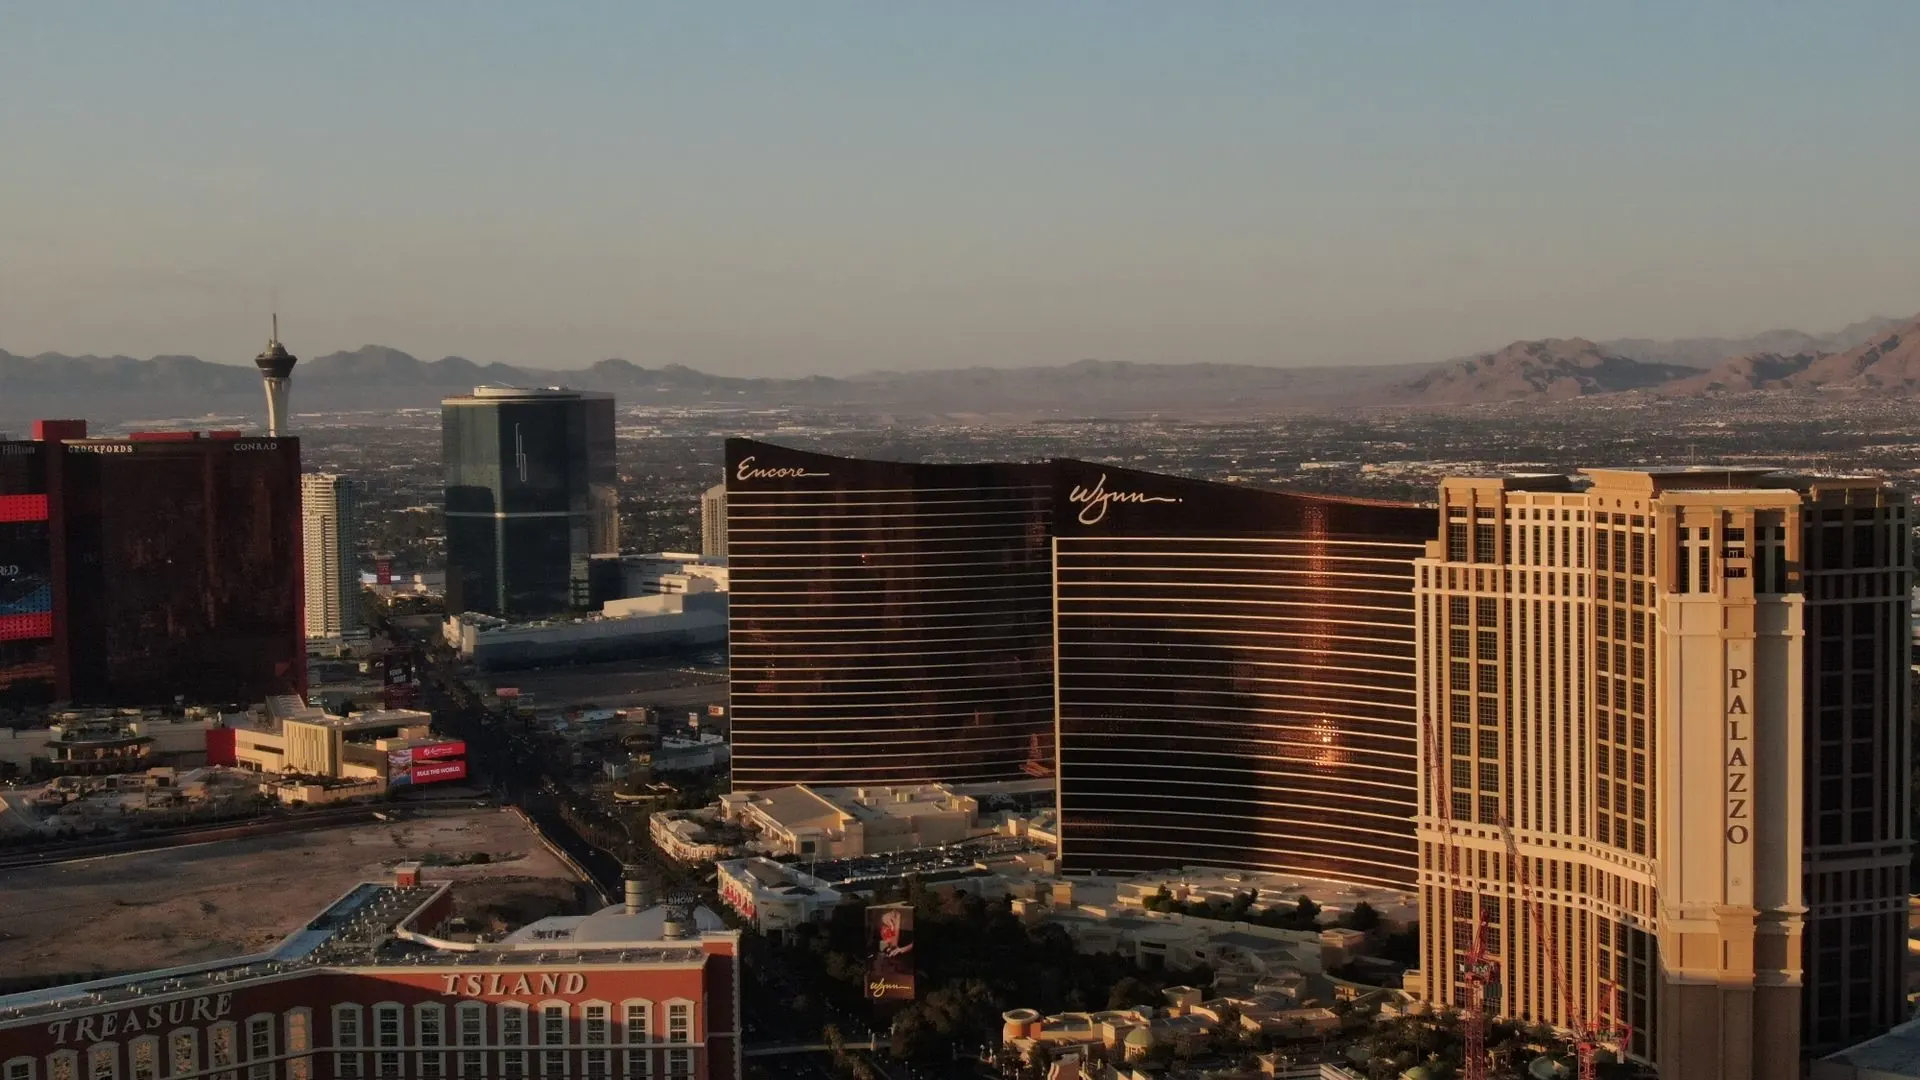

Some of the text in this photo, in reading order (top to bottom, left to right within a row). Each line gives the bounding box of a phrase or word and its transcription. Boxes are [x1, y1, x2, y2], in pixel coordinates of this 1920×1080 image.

[68, 445, 134, 454] CROCKFORDS
[233, 443, 278, 451] CONRAD
[736, 455, 831, 481] Encore
[1727, 668, 1749, 846] PALAZZO
[47, 972, 586, 1046] TREASURE ISLAND
